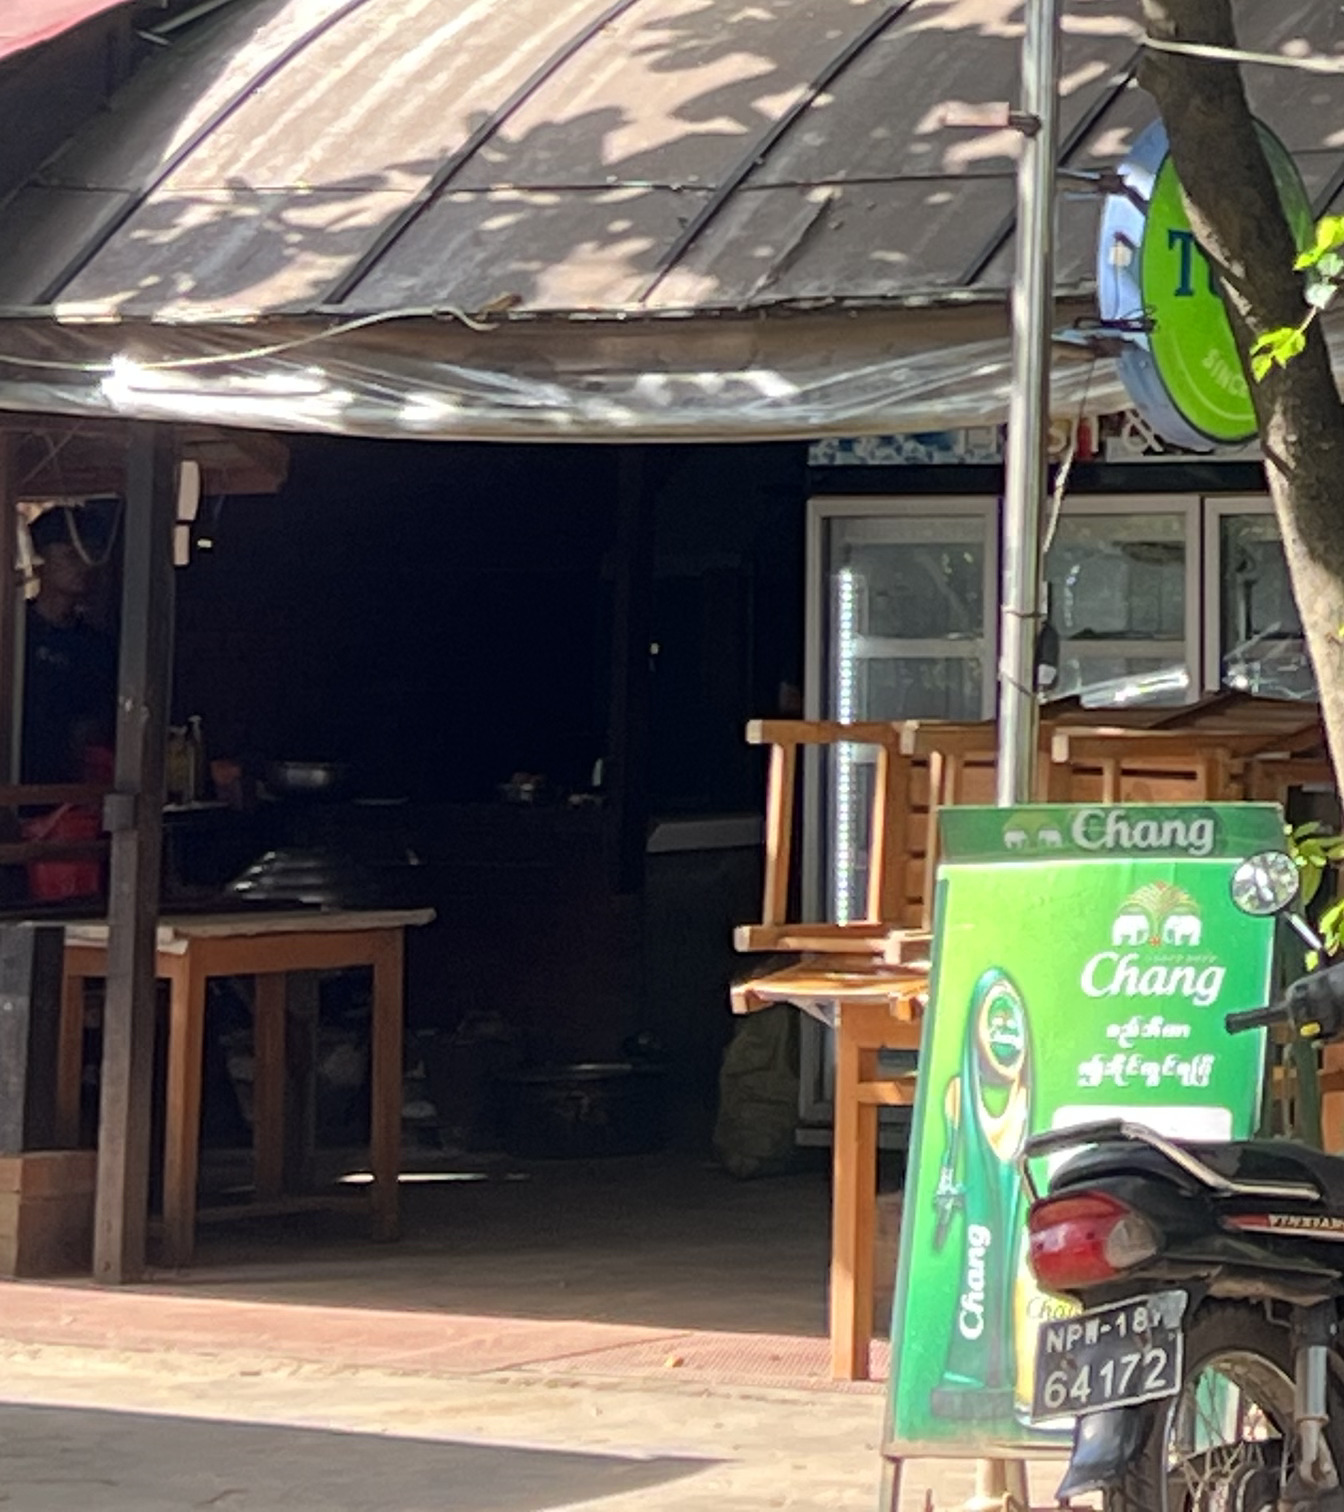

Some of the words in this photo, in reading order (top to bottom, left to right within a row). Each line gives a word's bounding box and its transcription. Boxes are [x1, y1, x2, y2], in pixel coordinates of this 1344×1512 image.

[1071, 809, 1214, 857] Chang
[1079, 951, 1226, 1006] Chang
[958, 1223, 992, 1341] Chang
[1044, 1348, 1168, 1409] 64172
